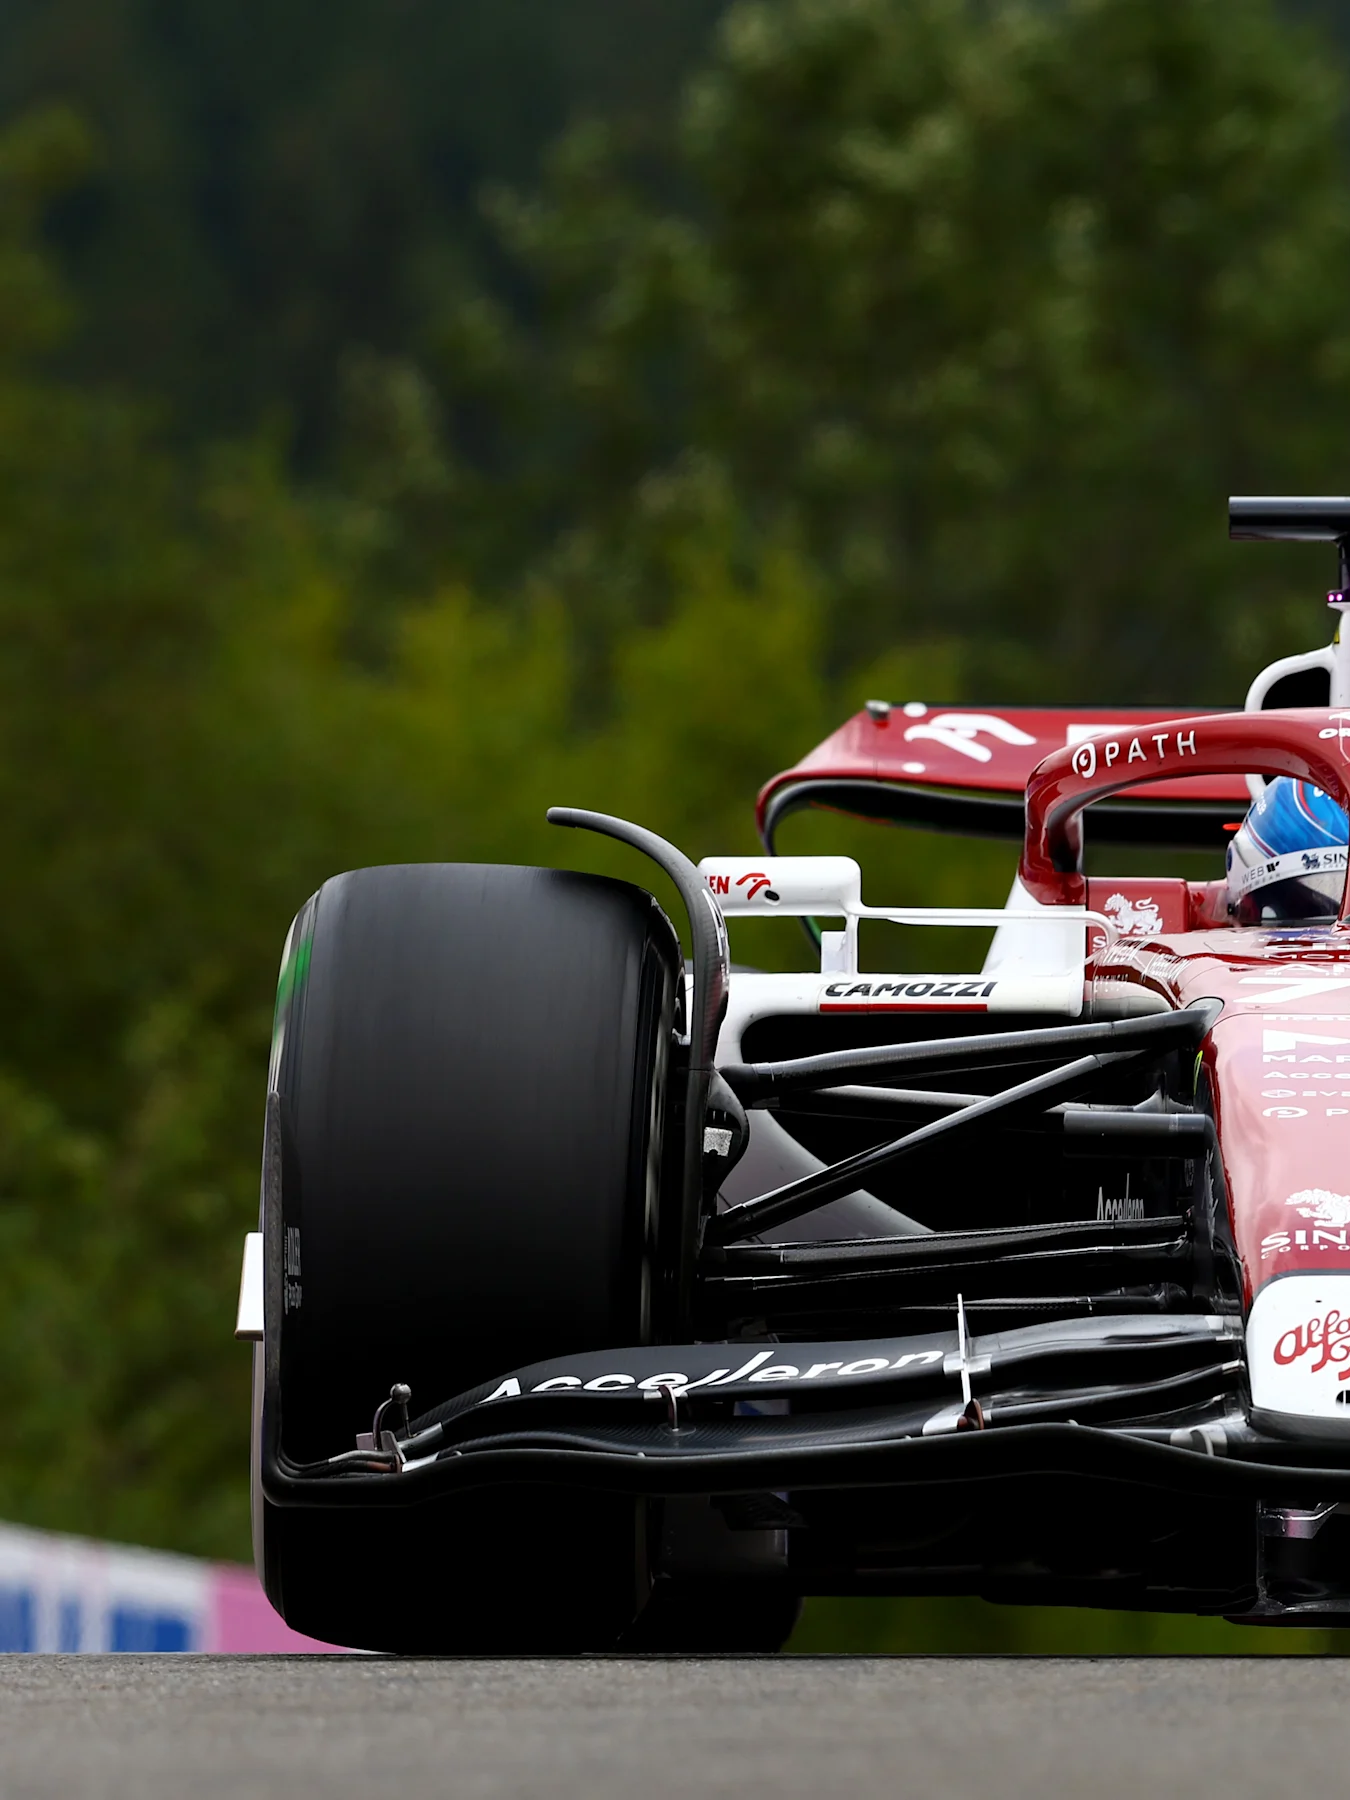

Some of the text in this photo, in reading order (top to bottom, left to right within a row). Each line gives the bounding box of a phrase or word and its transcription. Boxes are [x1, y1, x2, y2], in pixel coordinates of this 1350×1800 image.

[1105, 730, 1197, 767] PATH
[1241, 866, 1264, 885] WEB
[825, 981, 998, 998] CAMOZZI
